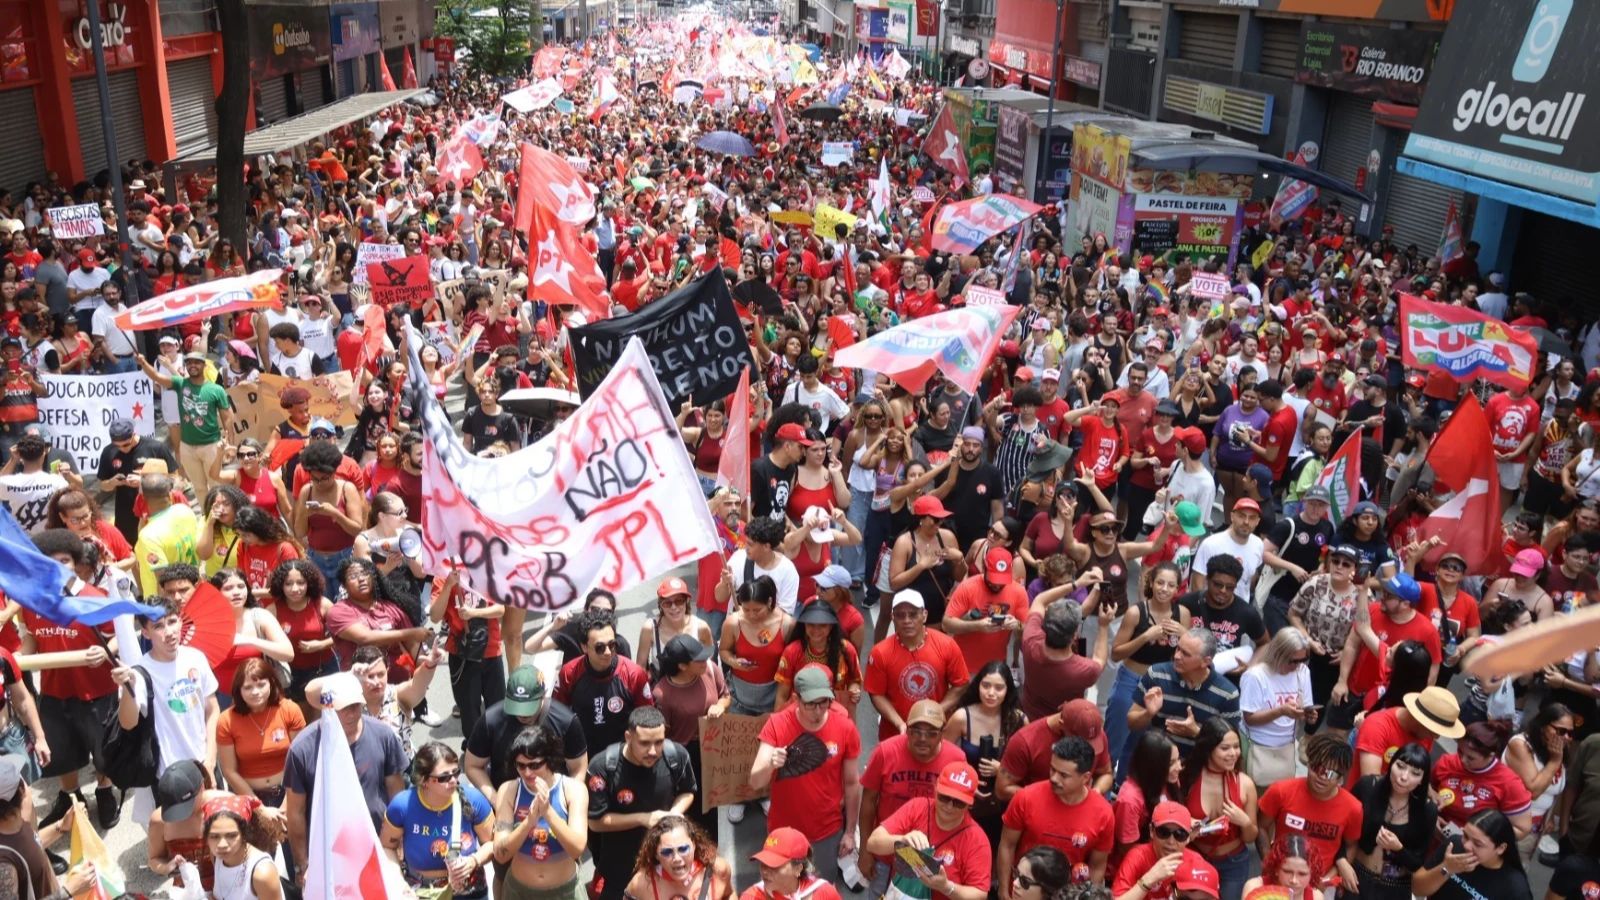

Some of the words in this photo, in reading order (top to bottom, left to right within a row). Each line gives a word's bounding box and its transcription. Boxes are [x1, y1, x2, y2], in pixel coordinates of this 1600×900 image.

[78, 17, 124, 49] Caro
[1361, 46, 1387, 59] Galeria
[1355, 59, 1376, 76] RIO
[1374, 62, 1425, 84] BRANCO
[1452, 80, 1586, 141] glocall
[50, 204, 100, 223] FASCISTAS
[1149, 199, 1183, 209] PASTEL
[1185, 202, 1198, 210] DE
[1199, 202, 1227, 212] FEIRA
[1190, 215, 1228, 225] PROMOÇÃO
[1201, 245, 1229, 254] PASTEL
[540, 249, 564, 273] PT
[1194, 279, 1224, 293] VOTE
[46, 379, 128, 398] DUCADORES
[133, 379, 151, 395] EM
